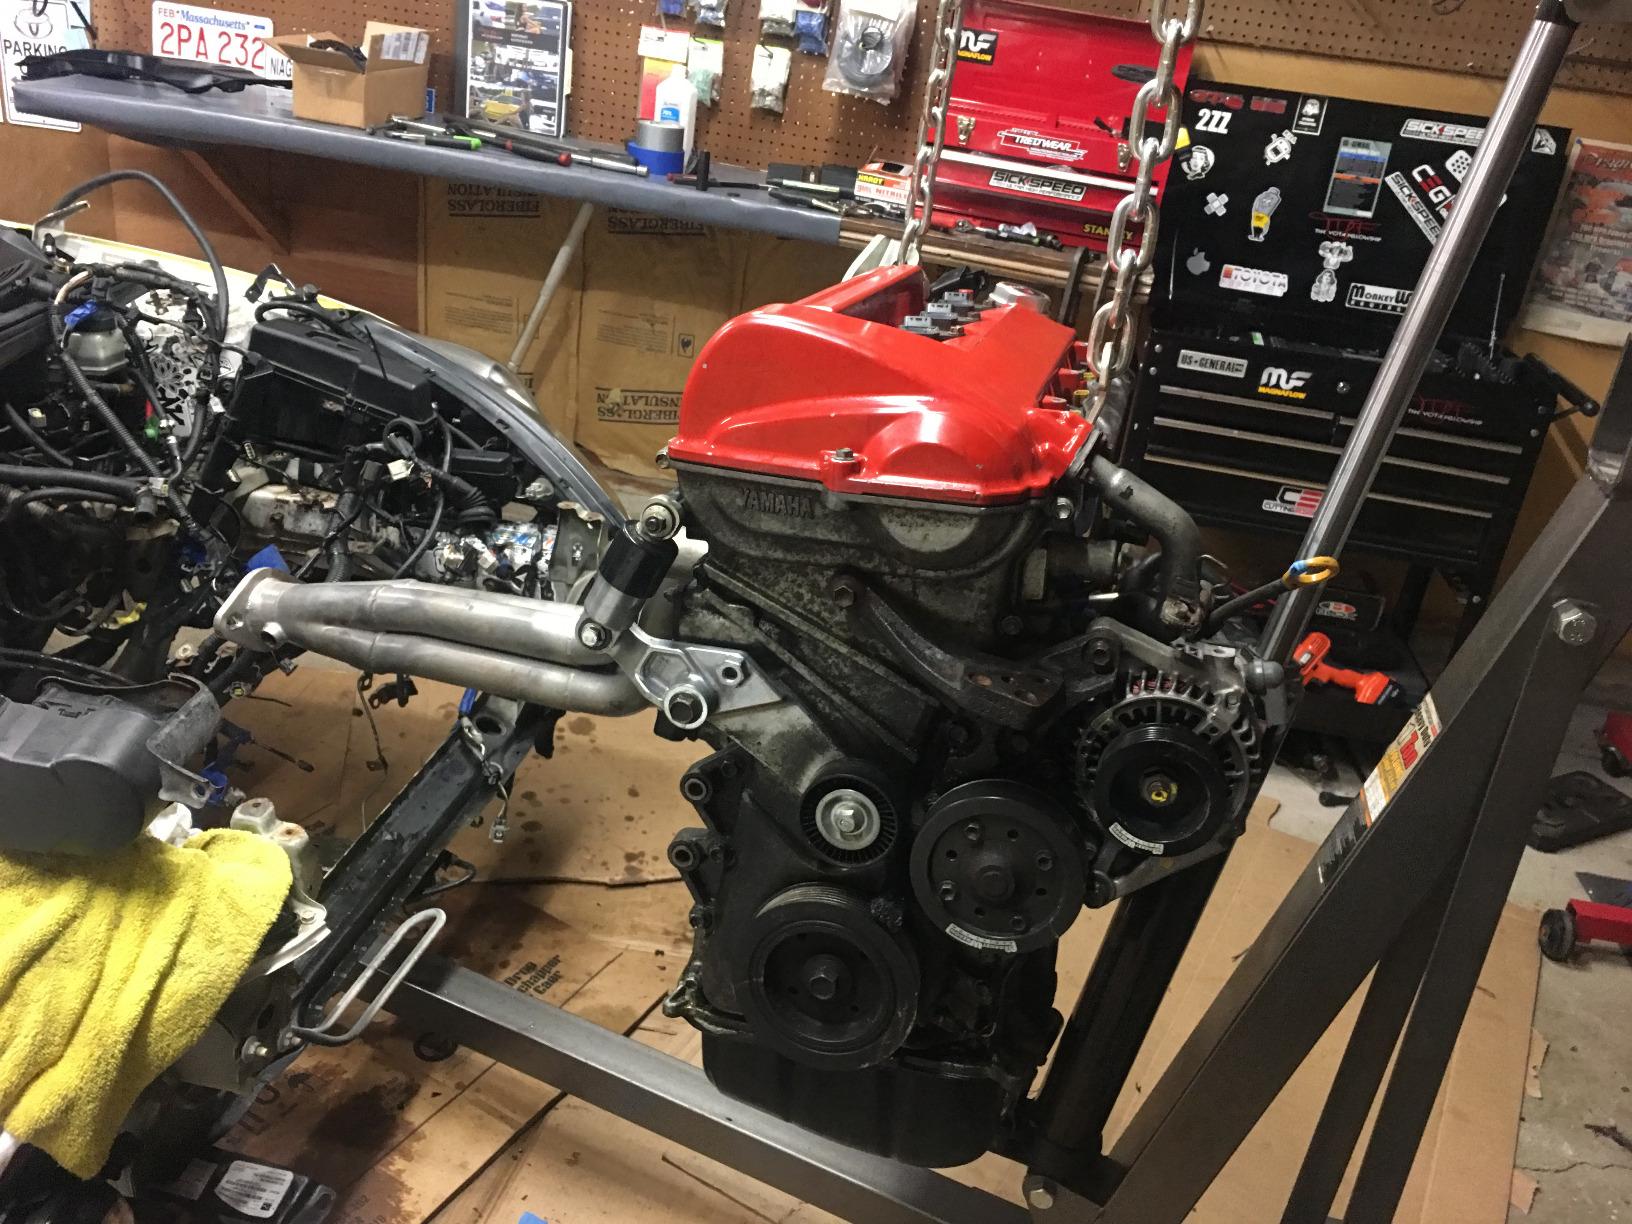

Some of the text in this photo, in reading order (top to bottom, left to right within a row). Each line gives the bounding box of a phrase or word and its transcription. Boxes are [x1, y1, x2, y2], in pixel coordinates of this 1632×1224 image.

[158, 7, 246, 30] FEB Massachusetts
[160, 21, 265, 70] 2PA 232
[1195, 108, 1232, 134] 2ZZ
[1083, 224, 1133, 240] STANY
[742, 487, 816, 519] YAMAHA
